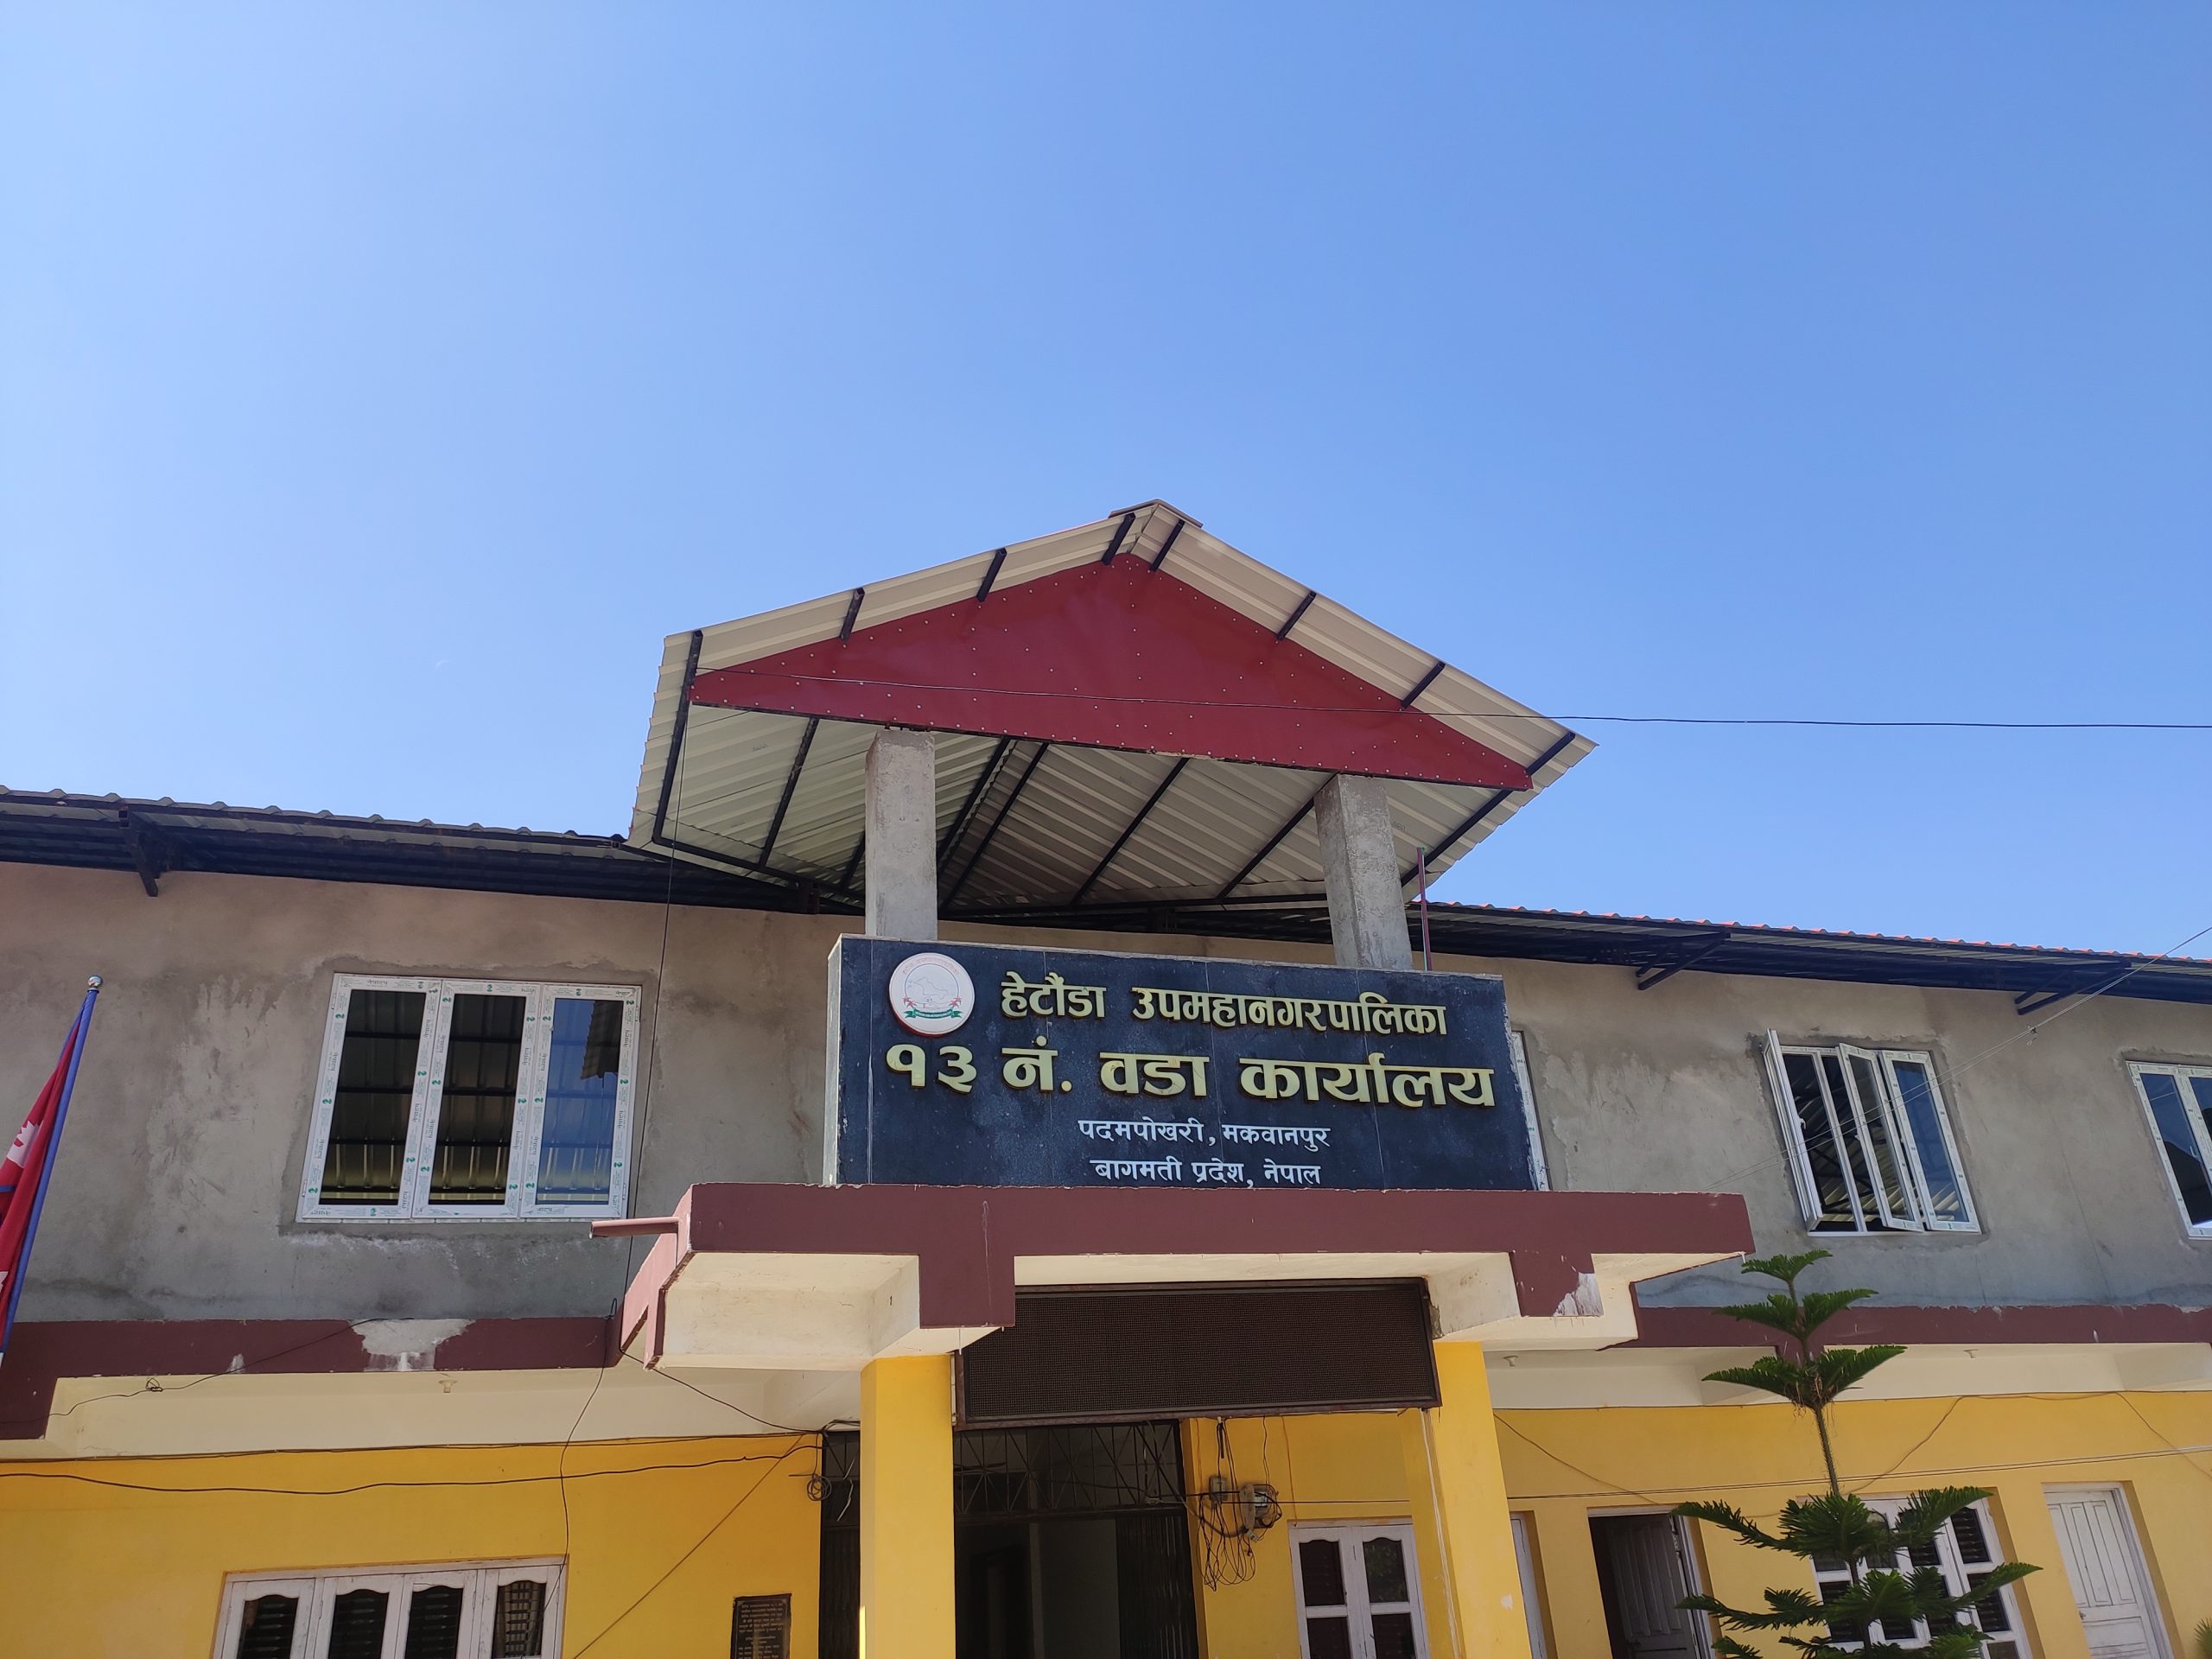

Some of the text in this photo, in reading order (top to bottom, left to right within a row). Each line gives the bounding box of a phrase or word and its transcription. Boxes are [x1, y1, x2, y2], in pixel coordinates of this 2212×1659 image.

[1131, 987, 1447, 1035] उपमहानगरपालिका
[886, 1035, 1495, 1108] १३ नं. वडा कार्यालय
[1221, 1124, 1332, 1152] मकवानपुर
[1089, 1155, 1183, 1181] बागमती
[1263, 1158, 1321, 1185] नेपाल
